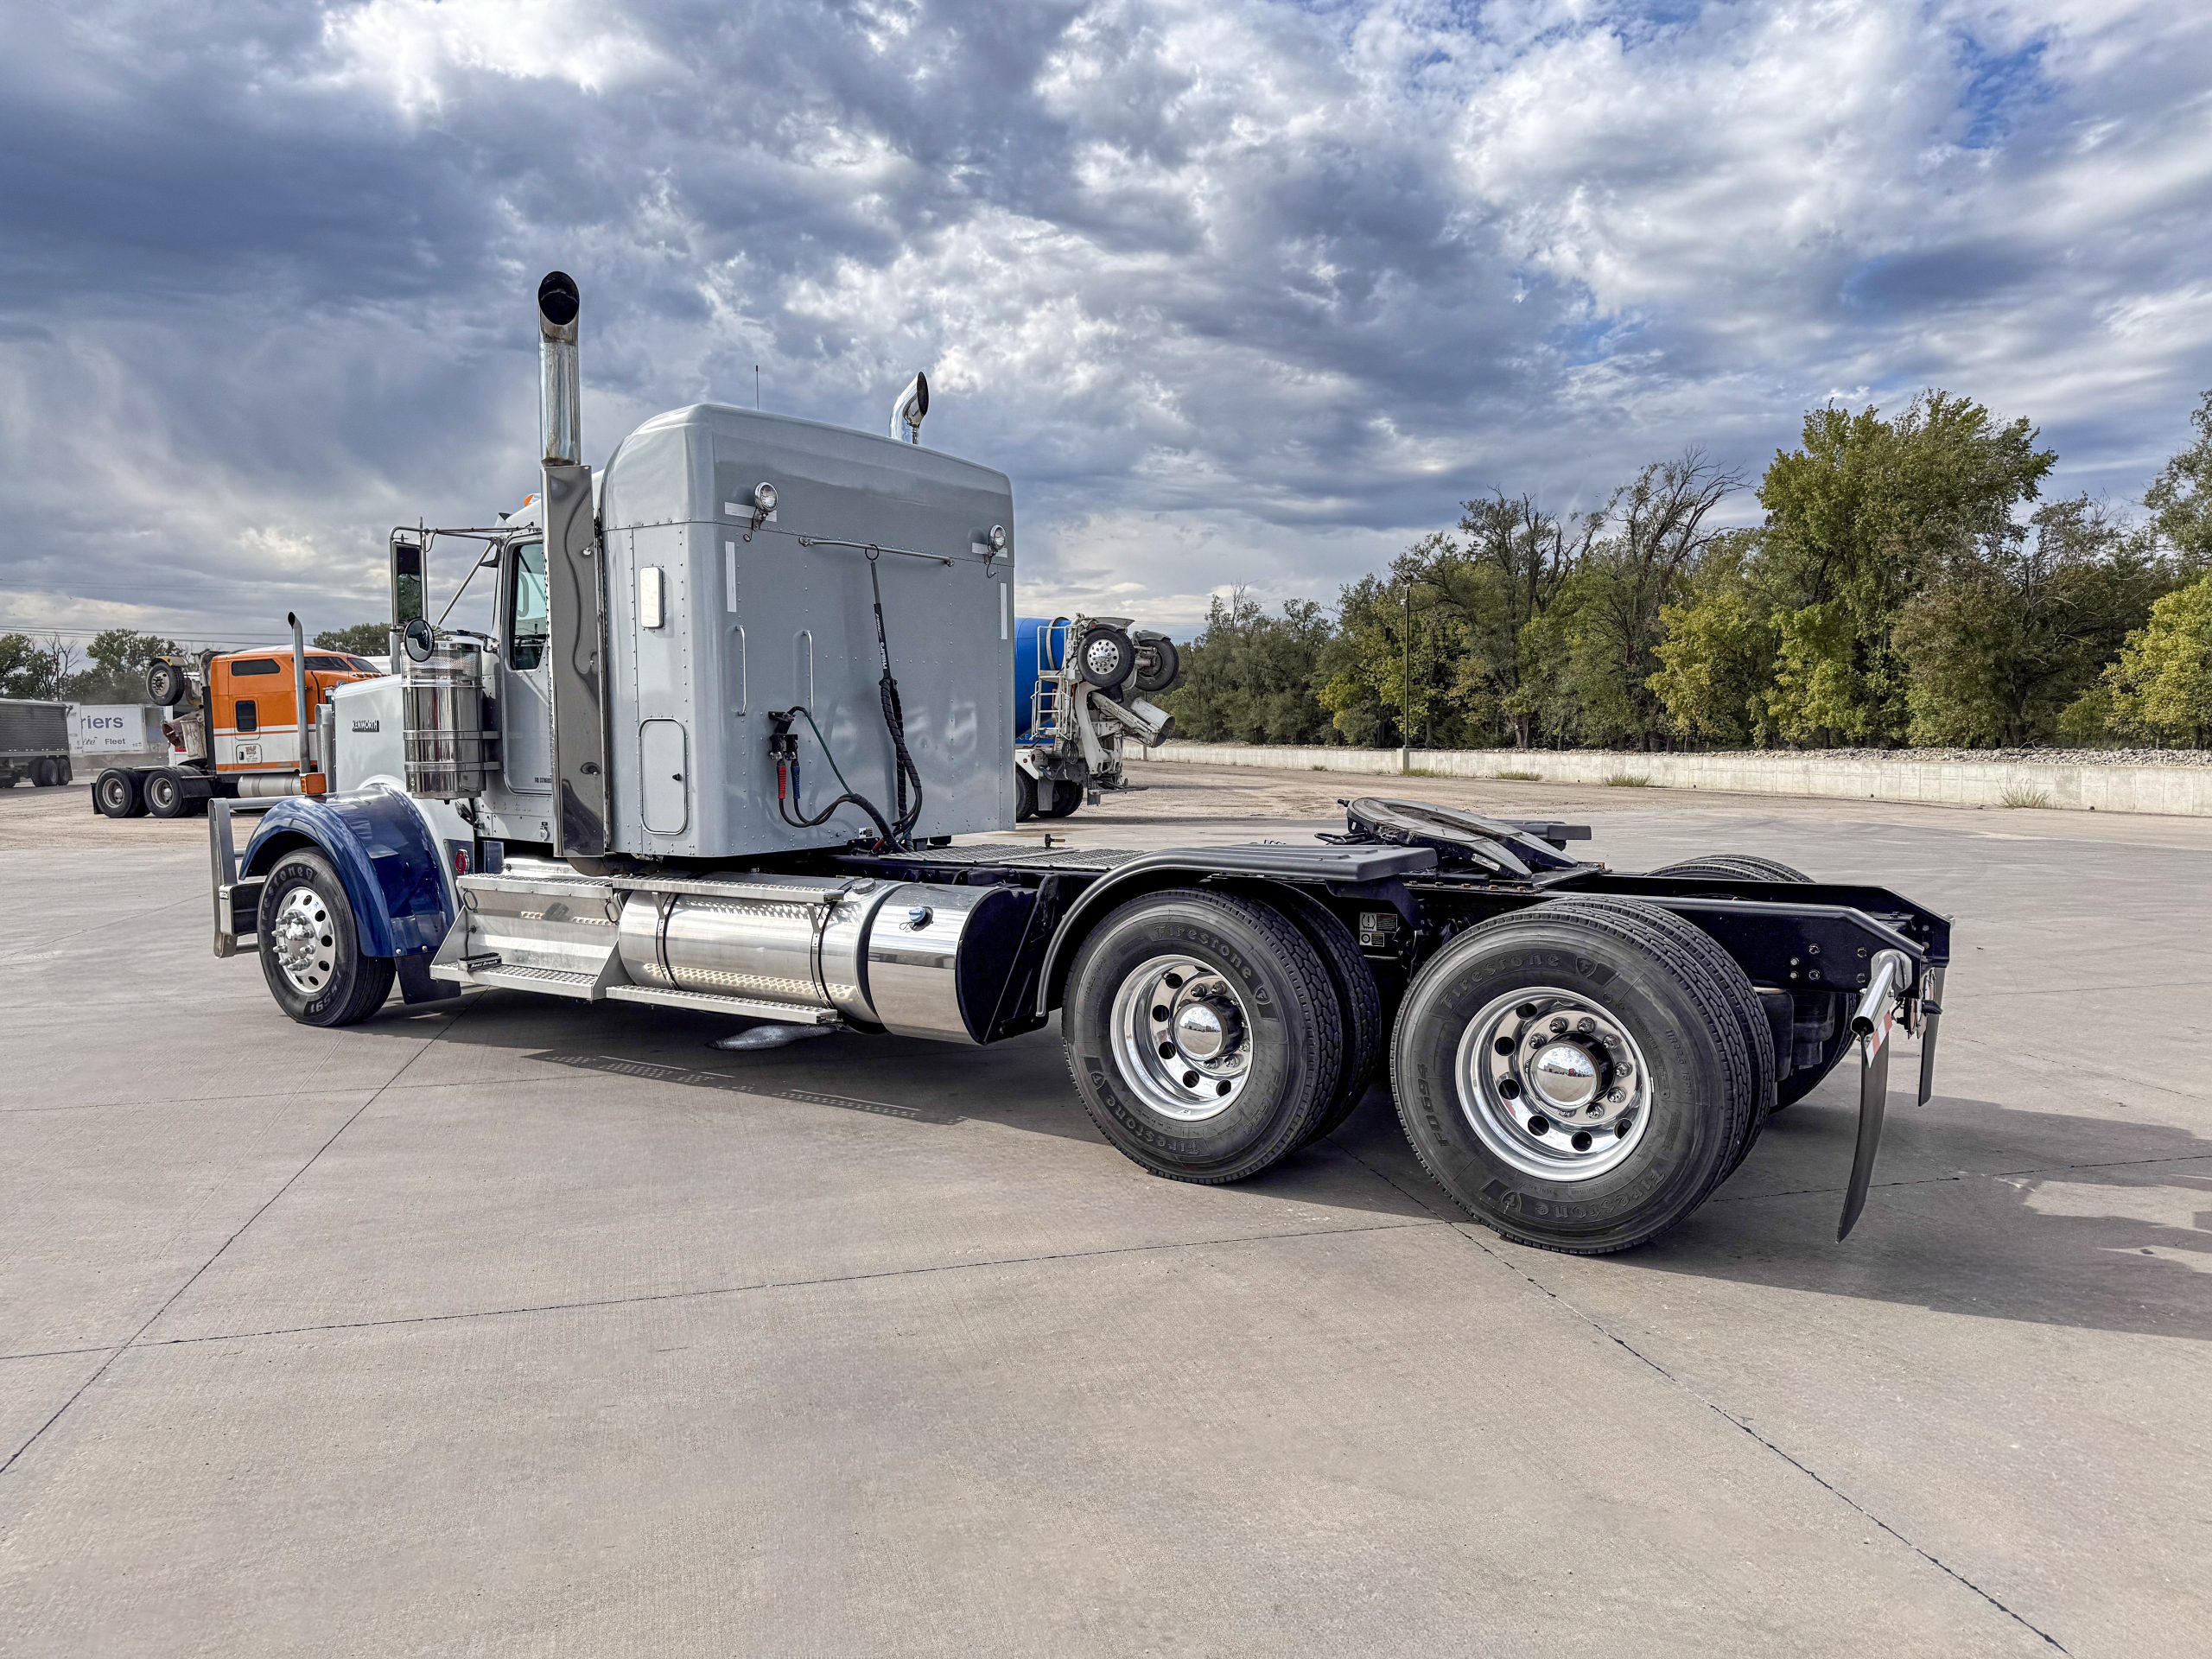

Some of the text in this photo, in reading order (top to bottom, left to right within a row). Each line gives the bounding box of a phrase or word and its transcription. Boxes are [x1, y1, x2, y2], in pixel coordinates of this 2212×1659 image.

[353, 720, 378, 731] KENWORTH
[1154, 925, 1252, 980] Firestone
[1440, 953, 1562, 1010] Firestone
[1105, 1096, 1200, 1155] Firestone
[1535, 1167, 1666, 1218] Firestone
